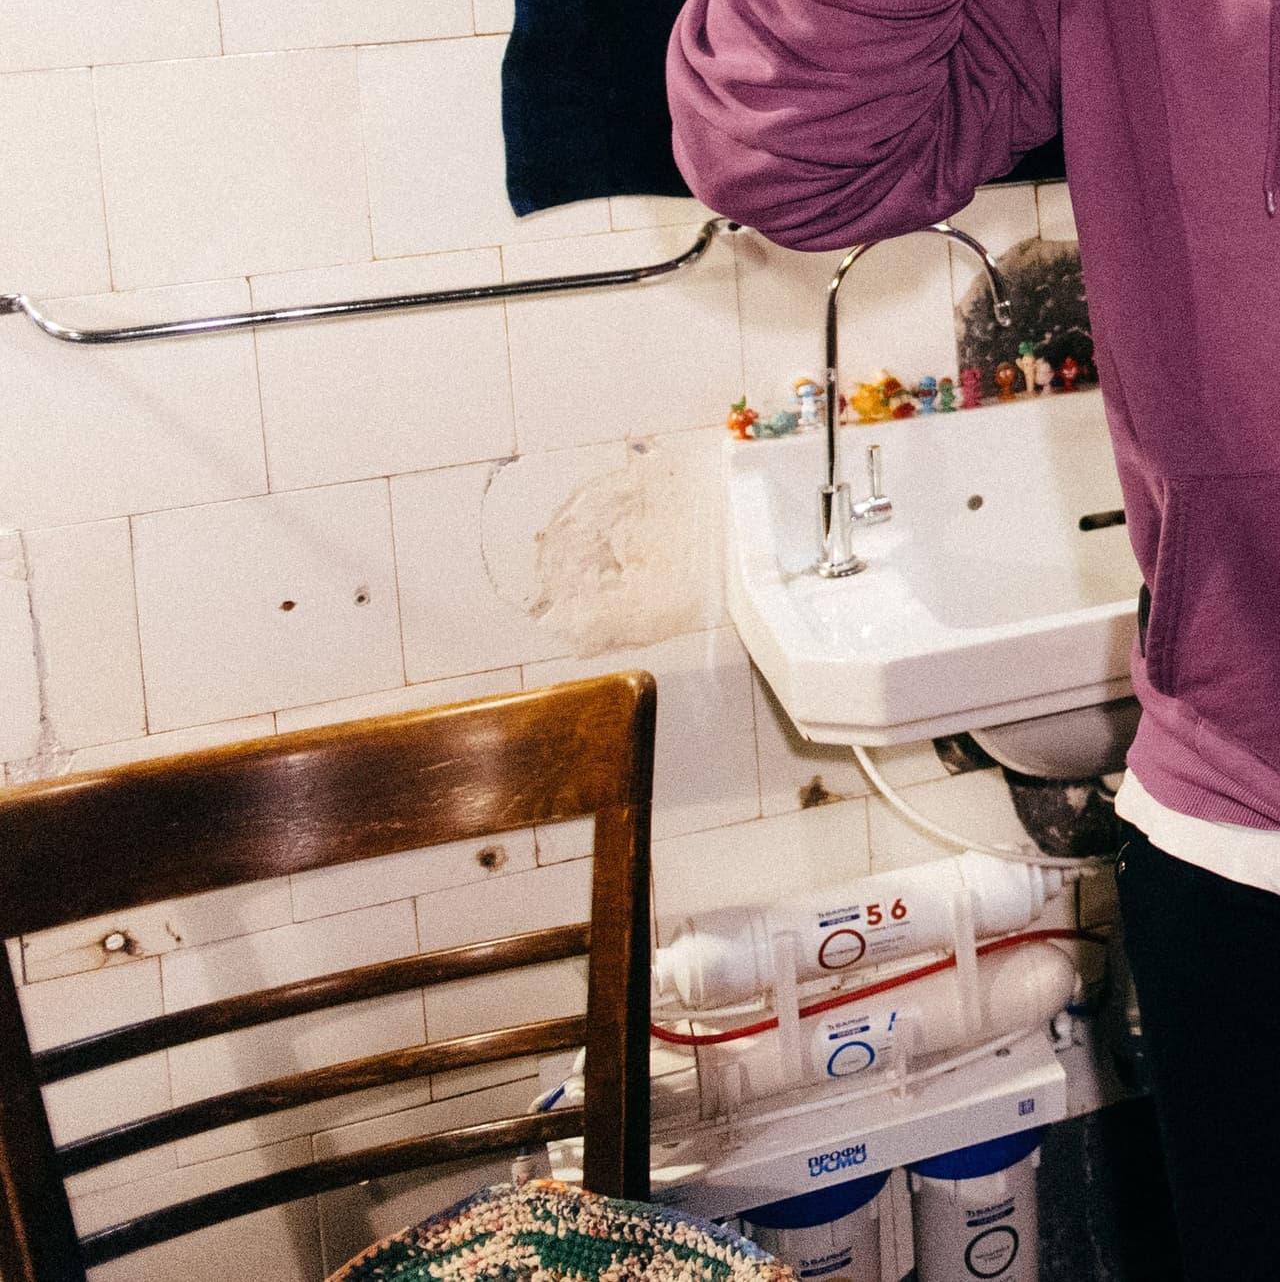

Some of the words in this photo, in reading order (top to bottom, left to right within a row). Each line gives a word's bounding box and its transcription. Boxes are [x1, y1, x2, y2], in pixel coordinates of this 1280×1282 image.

[866, 903, 882, 926] 5
[891, 898, 907, 920] 6
[808, 1143, 866, 1168] ПРОФИ
